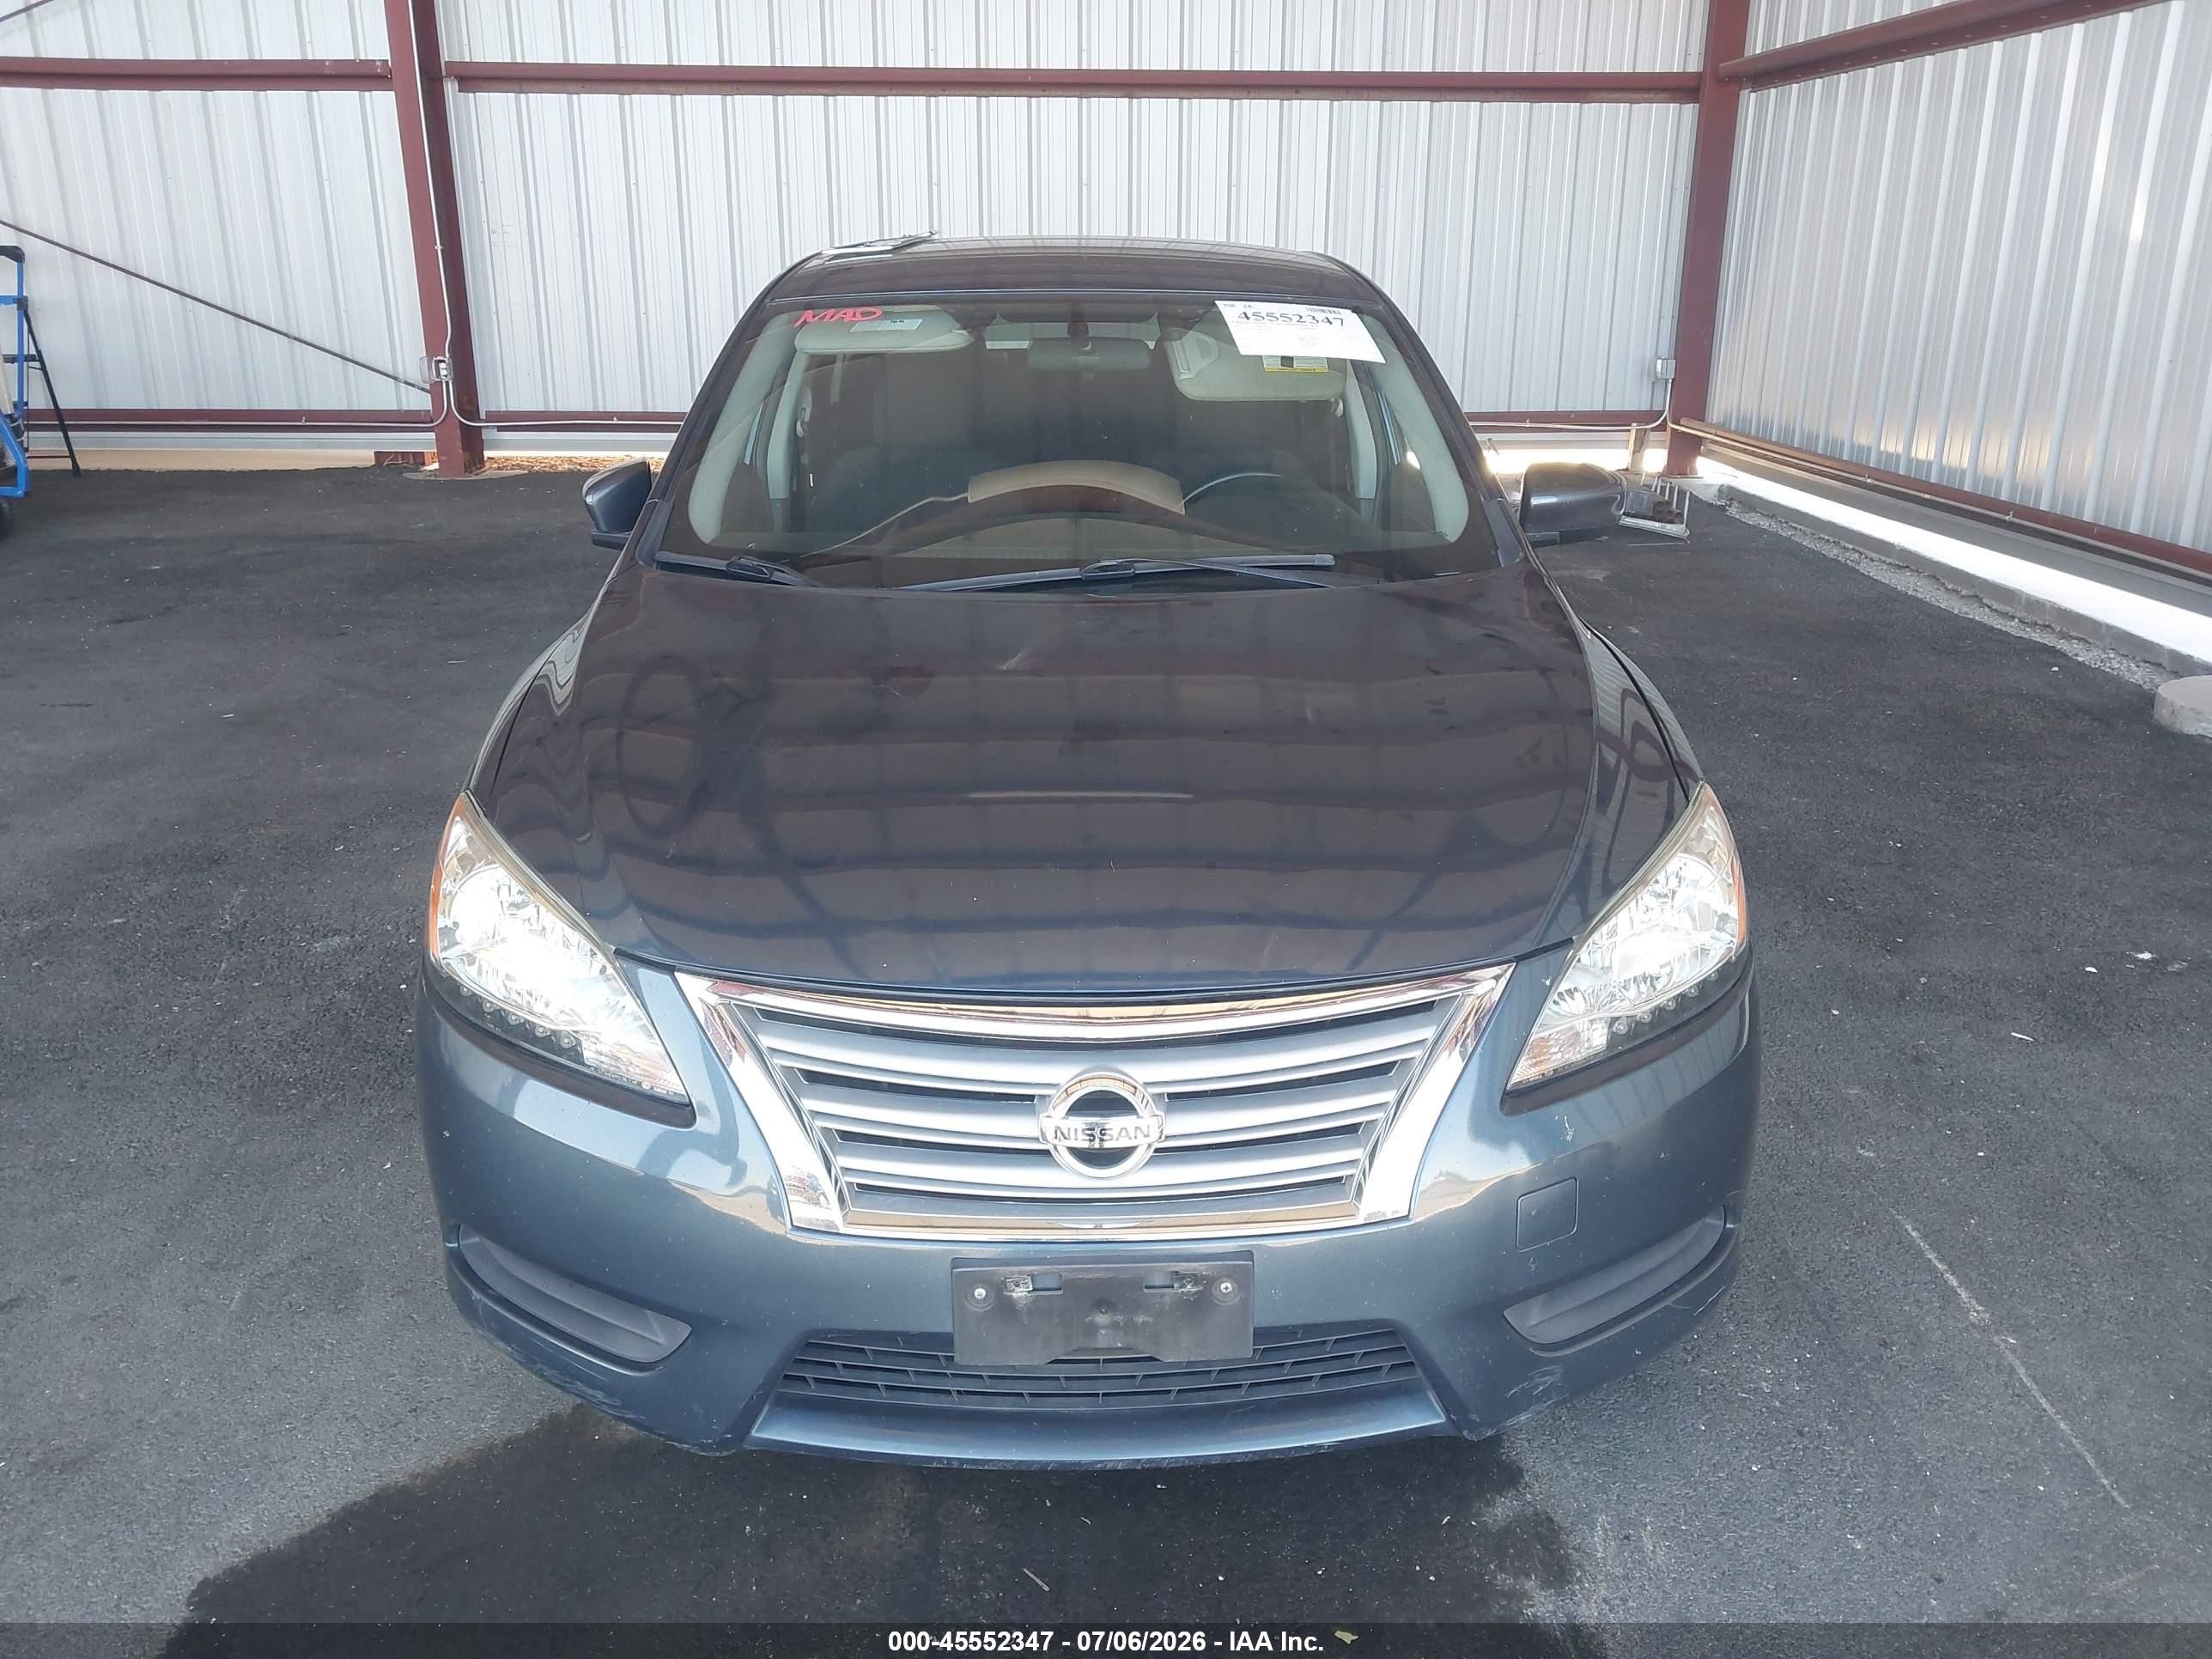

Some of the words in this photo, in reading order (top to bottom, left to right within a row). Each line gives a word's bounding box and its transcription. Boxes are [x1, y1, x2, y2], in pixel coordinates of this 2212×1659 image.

[793, 307, 883, 328] MAD
[1237, 311, 1344, 326] 45552347
[1054, 1125, 1151, 1141] NISSAN
